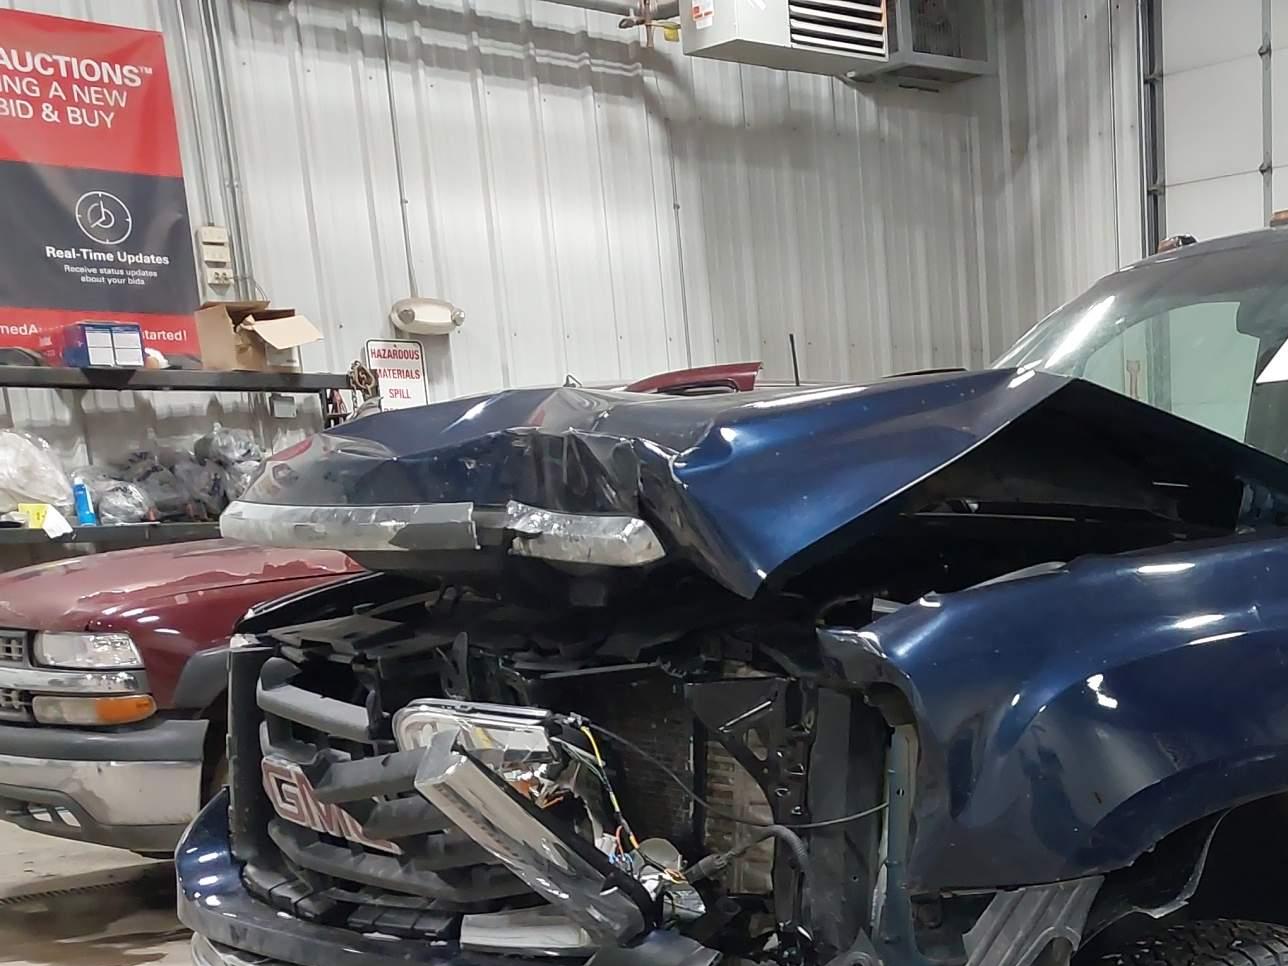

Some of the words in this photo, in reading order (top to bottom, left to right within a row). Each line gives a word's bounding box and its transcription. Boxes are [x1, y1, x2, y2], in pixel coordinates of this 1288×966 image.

[49, 82, 66, 100] A
[73, 85, 127, 108] NEW
[0, 98, 33, 119] BID
[42, 103, 60, 123] &
[67, 106, 114, 129] BUY
[45, 245, 114, 261] Real-Time
[117, 251, 170, 265] Updates
[64, 264, 97, 274] Receive
[99, 267, 124, 276] status
[126, 270, 158, 279] updates
[80, 275, 105, 283] about
[107, 277, 126, 285] your
[128, 277, 145, 285] bids
[143, 329, 188, 341] tarted!
[370, 348, 420, 360] HAZARDOUS
[376, 368, 421, 380] MATERIALS
[388, 388, 411, 399] SPILL
